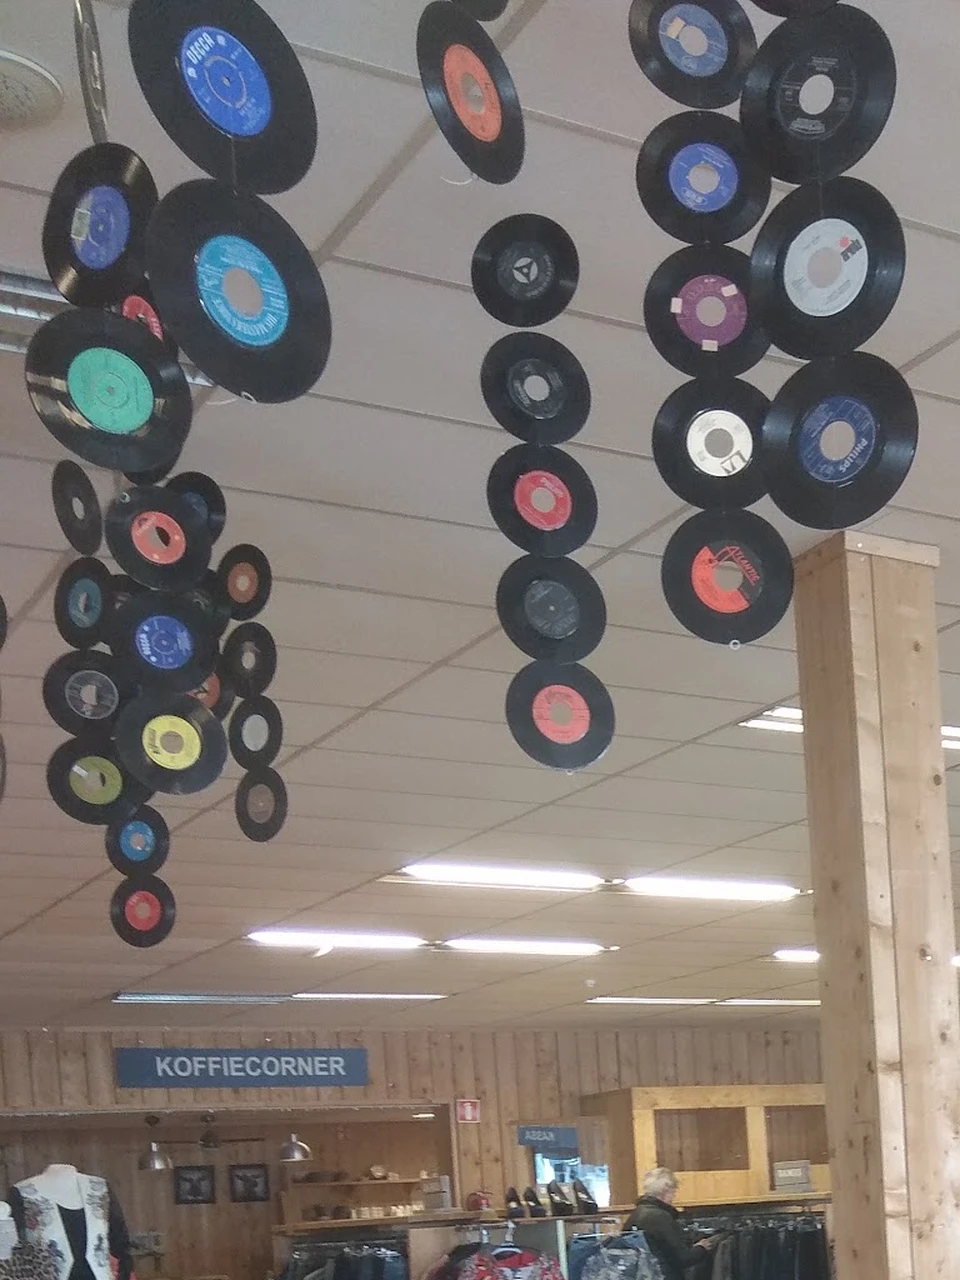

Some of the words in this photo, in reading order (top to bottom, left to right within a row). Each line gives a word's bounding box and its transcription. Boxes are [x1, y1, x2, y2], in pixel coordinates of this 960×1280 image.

[186, 32, 215, 65] DECCA
[839, 438, 868, 473] PHILIPS
[711, 545, 761, 587] ATLANTIC
[155, 1056, 346, 1077] KOFFIECORNER
